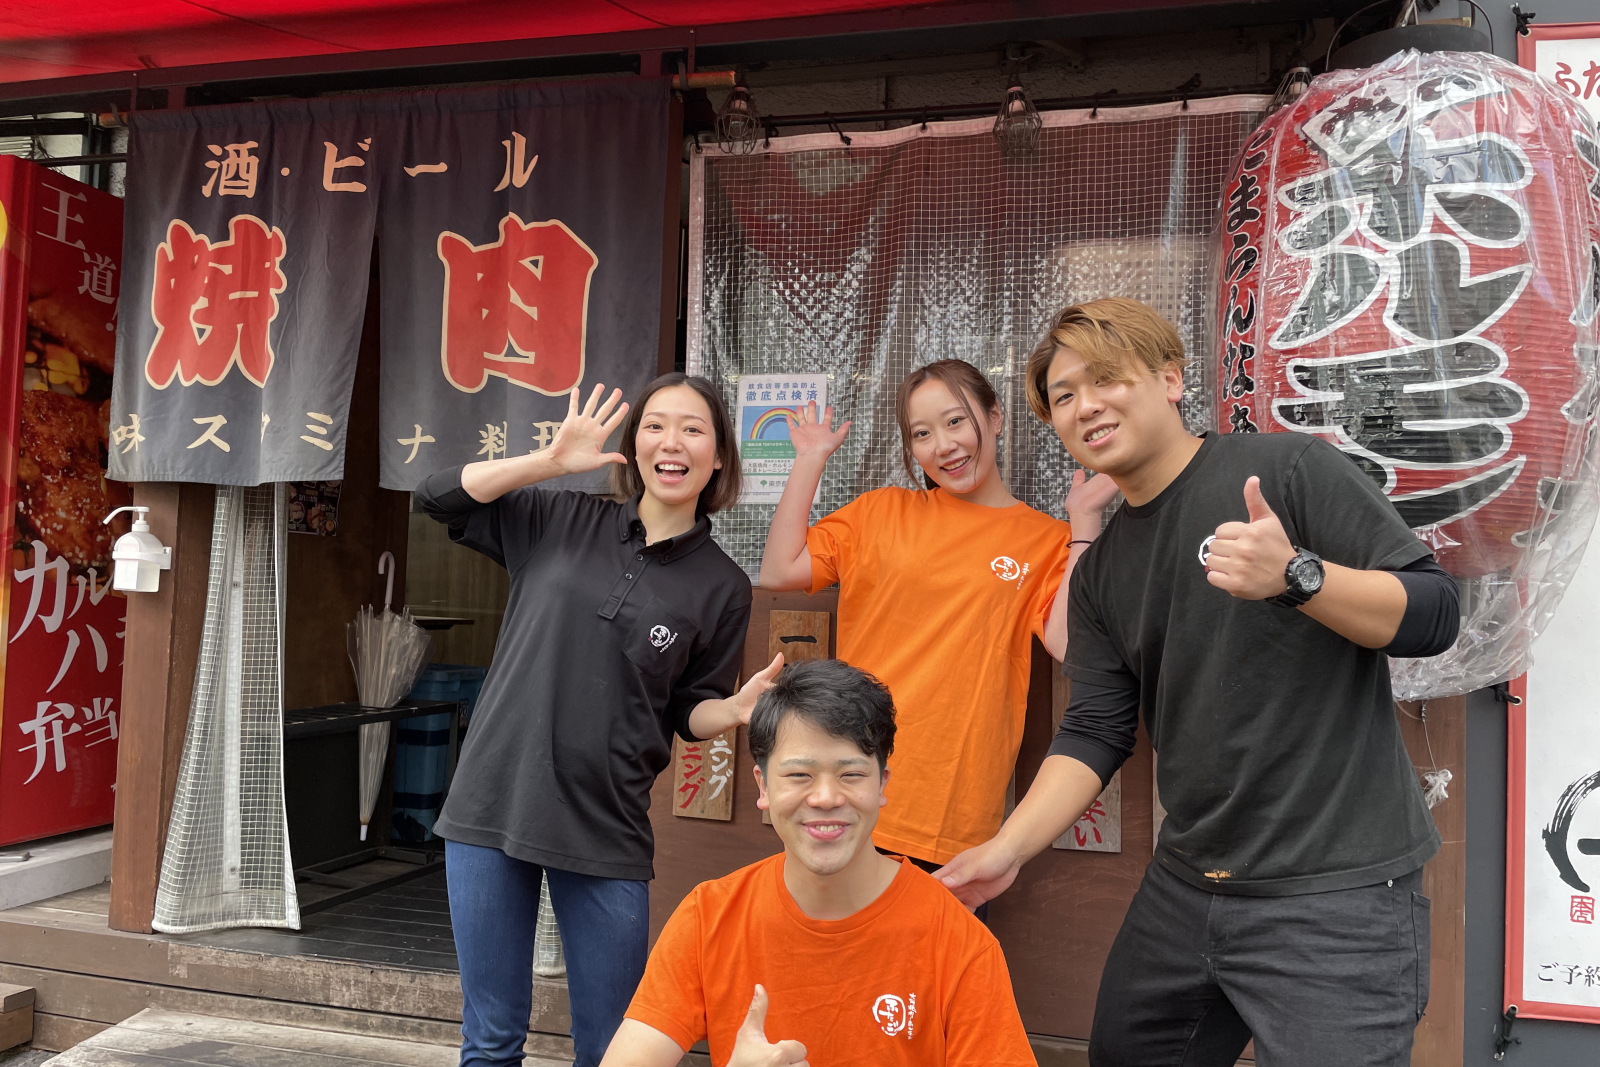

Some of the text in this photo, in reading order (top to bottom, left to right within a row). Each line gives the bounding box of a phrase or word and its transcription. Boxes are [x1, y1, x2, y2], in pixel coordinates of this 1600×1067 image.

[202, 131, 539, 198] 酒・ビール
[145, 211, 599, 397] 焼肉
[746, 390, 818, 402] 徹底点検済
[18, 697, 119, 785] 弁当
